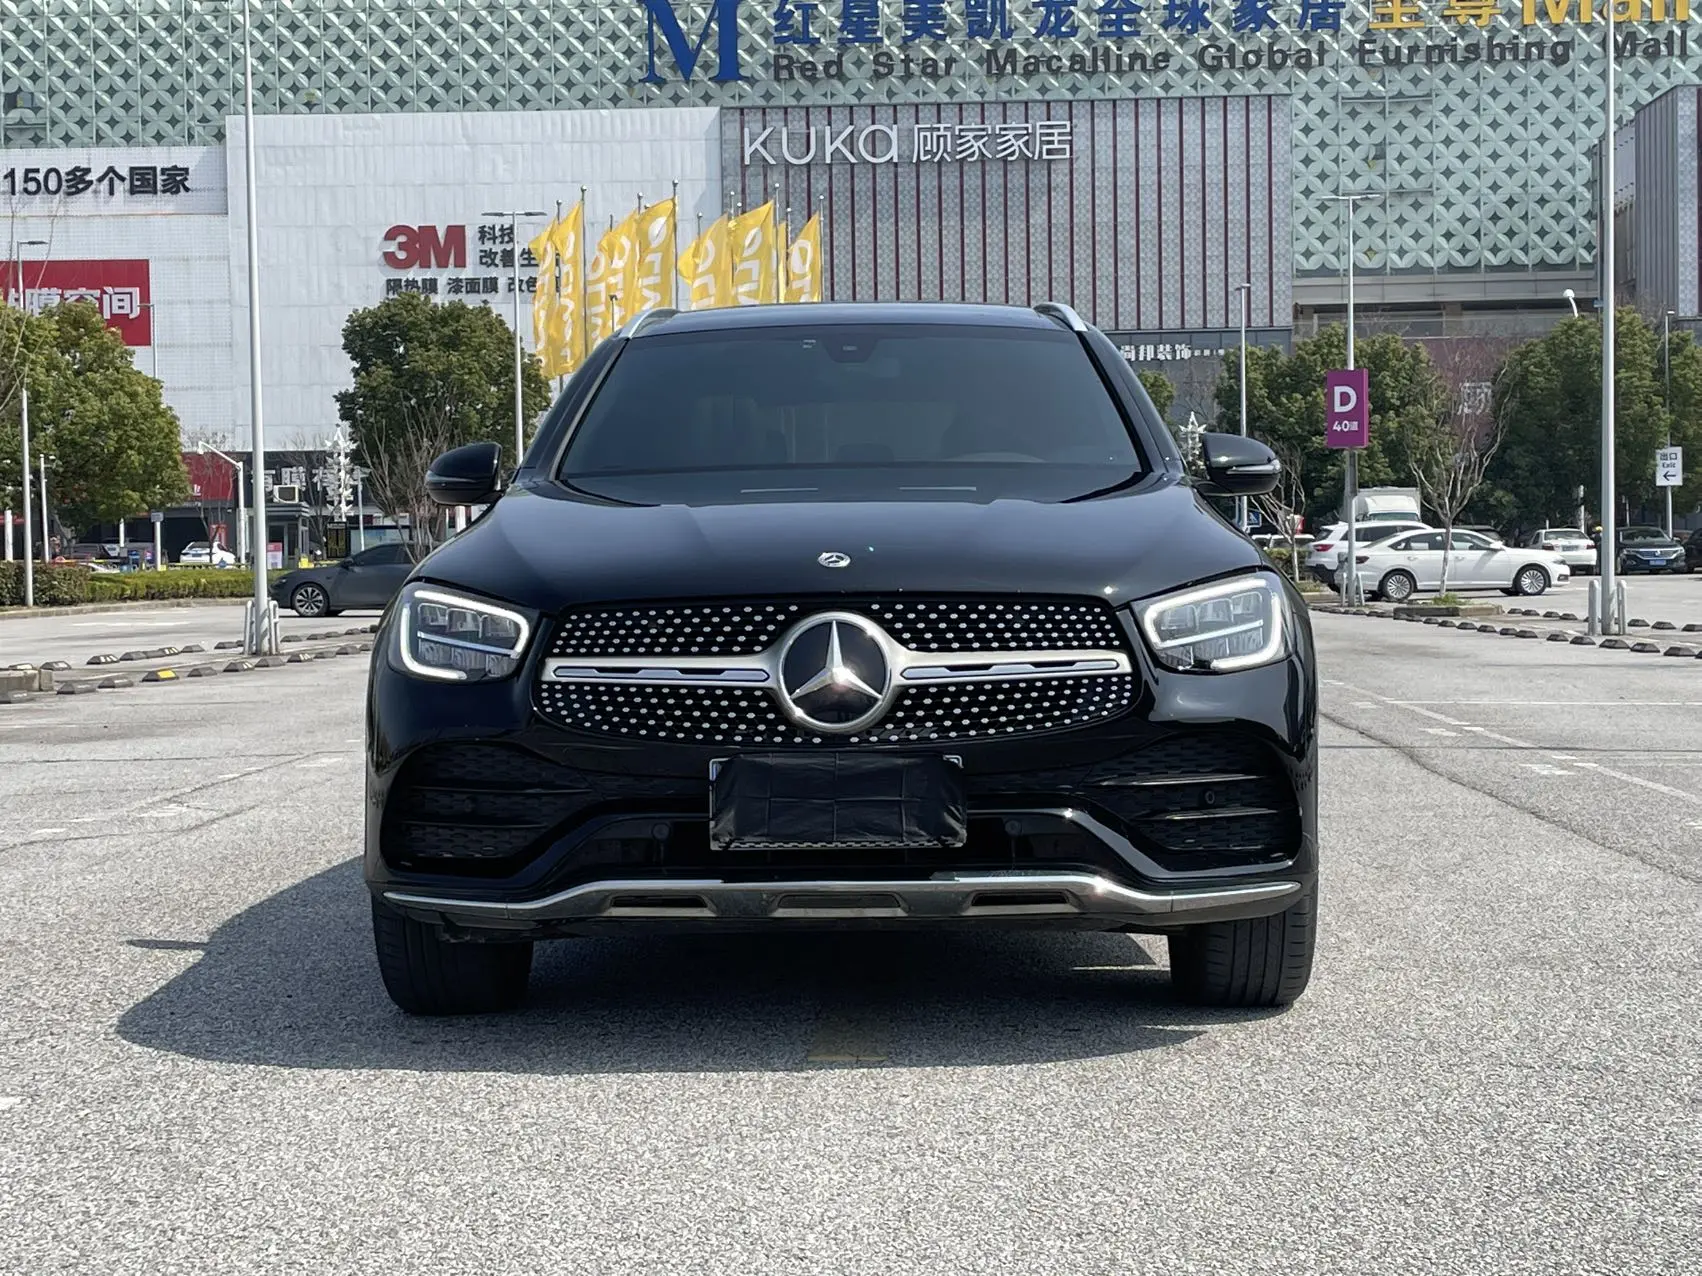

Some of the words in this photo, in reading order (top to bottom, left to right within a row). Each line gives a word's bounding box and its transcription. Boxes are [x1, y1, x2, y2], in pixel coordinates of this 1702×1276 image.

[639, 0, 752, 83] M
[773, 53, 844, 81] Red
[872, 50, 958, 79] Star
[986, 46, 1172, 76] Macalline
[1199, 40, 1326, 72] Global
[1358, 35, 1575, 67] Furnishing
[1602, 30, 1690, 59] Mall
[912, 120, 1073, 164] 顾家家居
[3, 165, 191, 196] 150多个国家
[382, 224, 467, 269] 3M
[478, 224, 518, 246] 科技
[447, 276, 499, 294] 漆面膜
[1333, 385, 1358, 413] D
